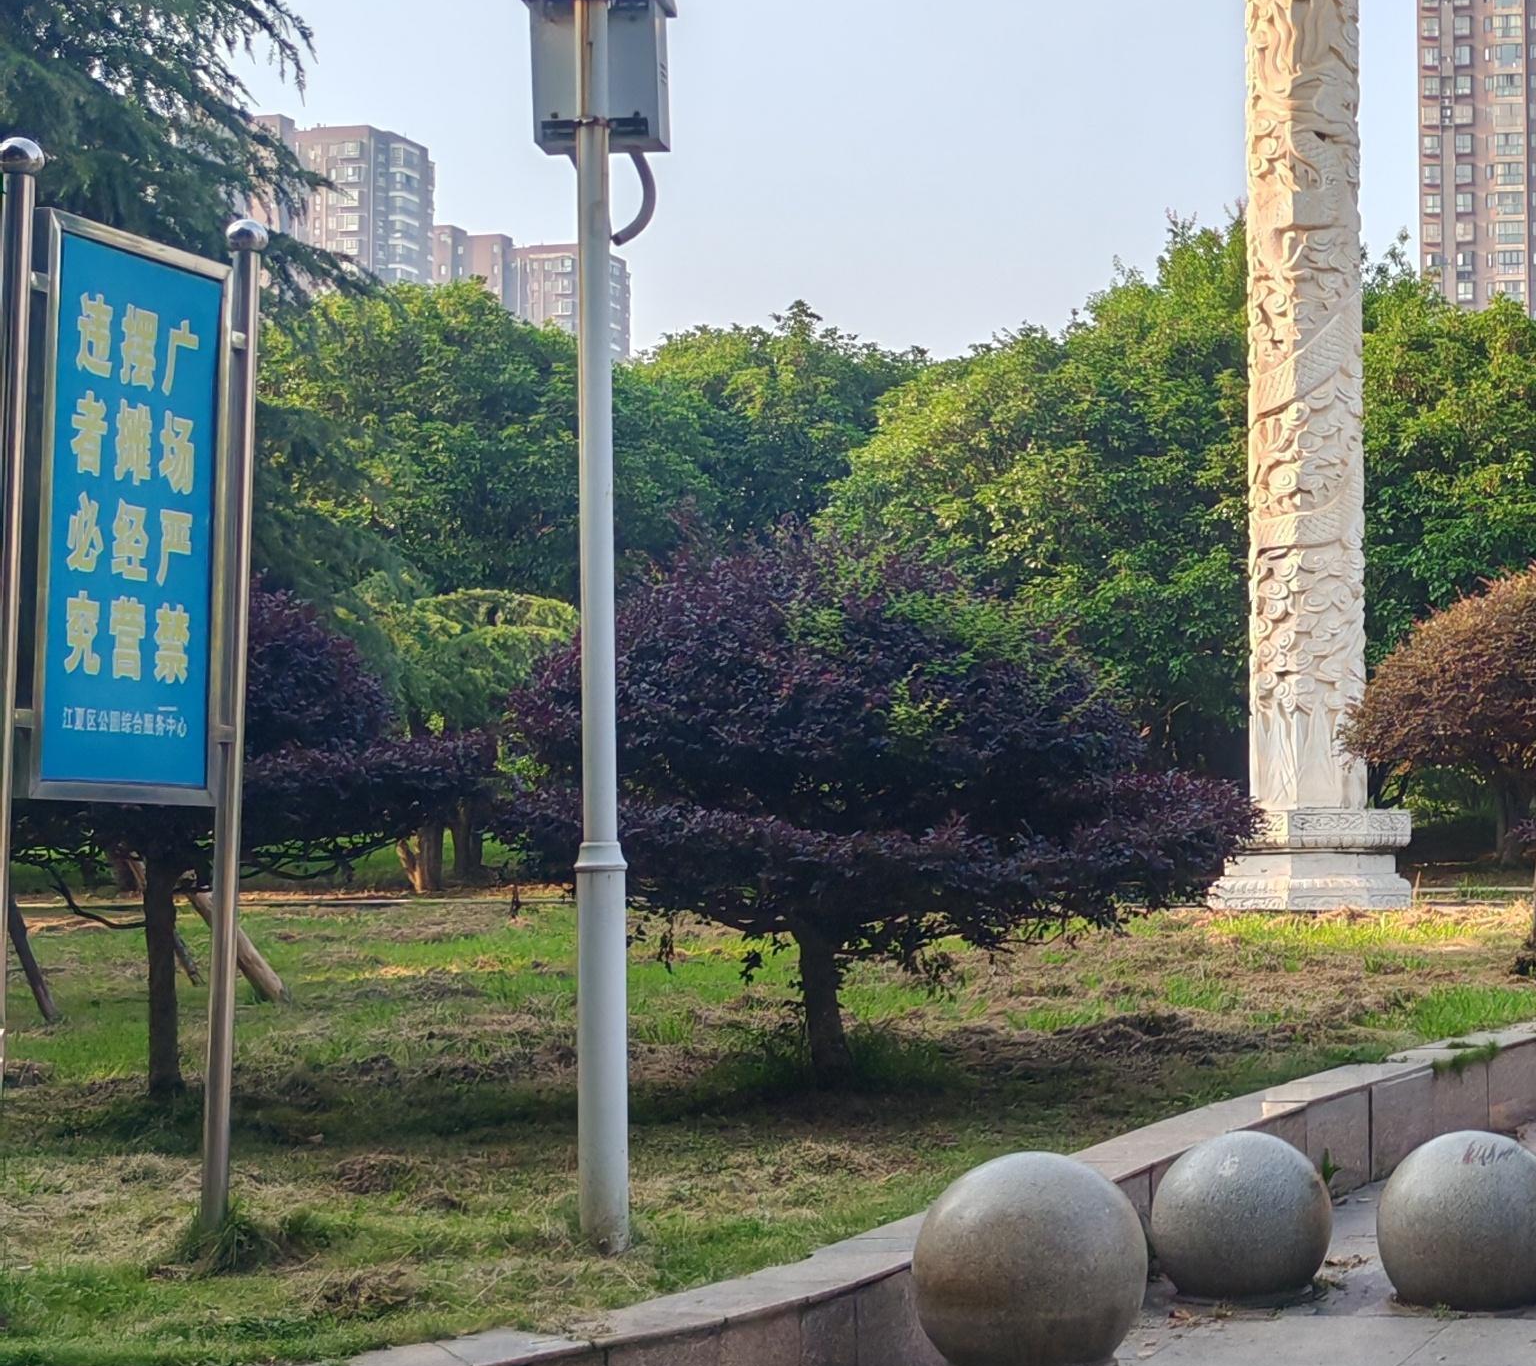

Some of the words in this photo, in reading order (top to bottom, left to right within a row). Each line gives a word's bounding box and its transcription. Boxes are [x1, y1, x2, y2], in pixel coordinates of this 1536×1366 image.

[64, 292, 113, 675] 违者必究
[109, 303, 158, 681] 摆摊经营
[154, 319, 199, 684] 广场严禁
